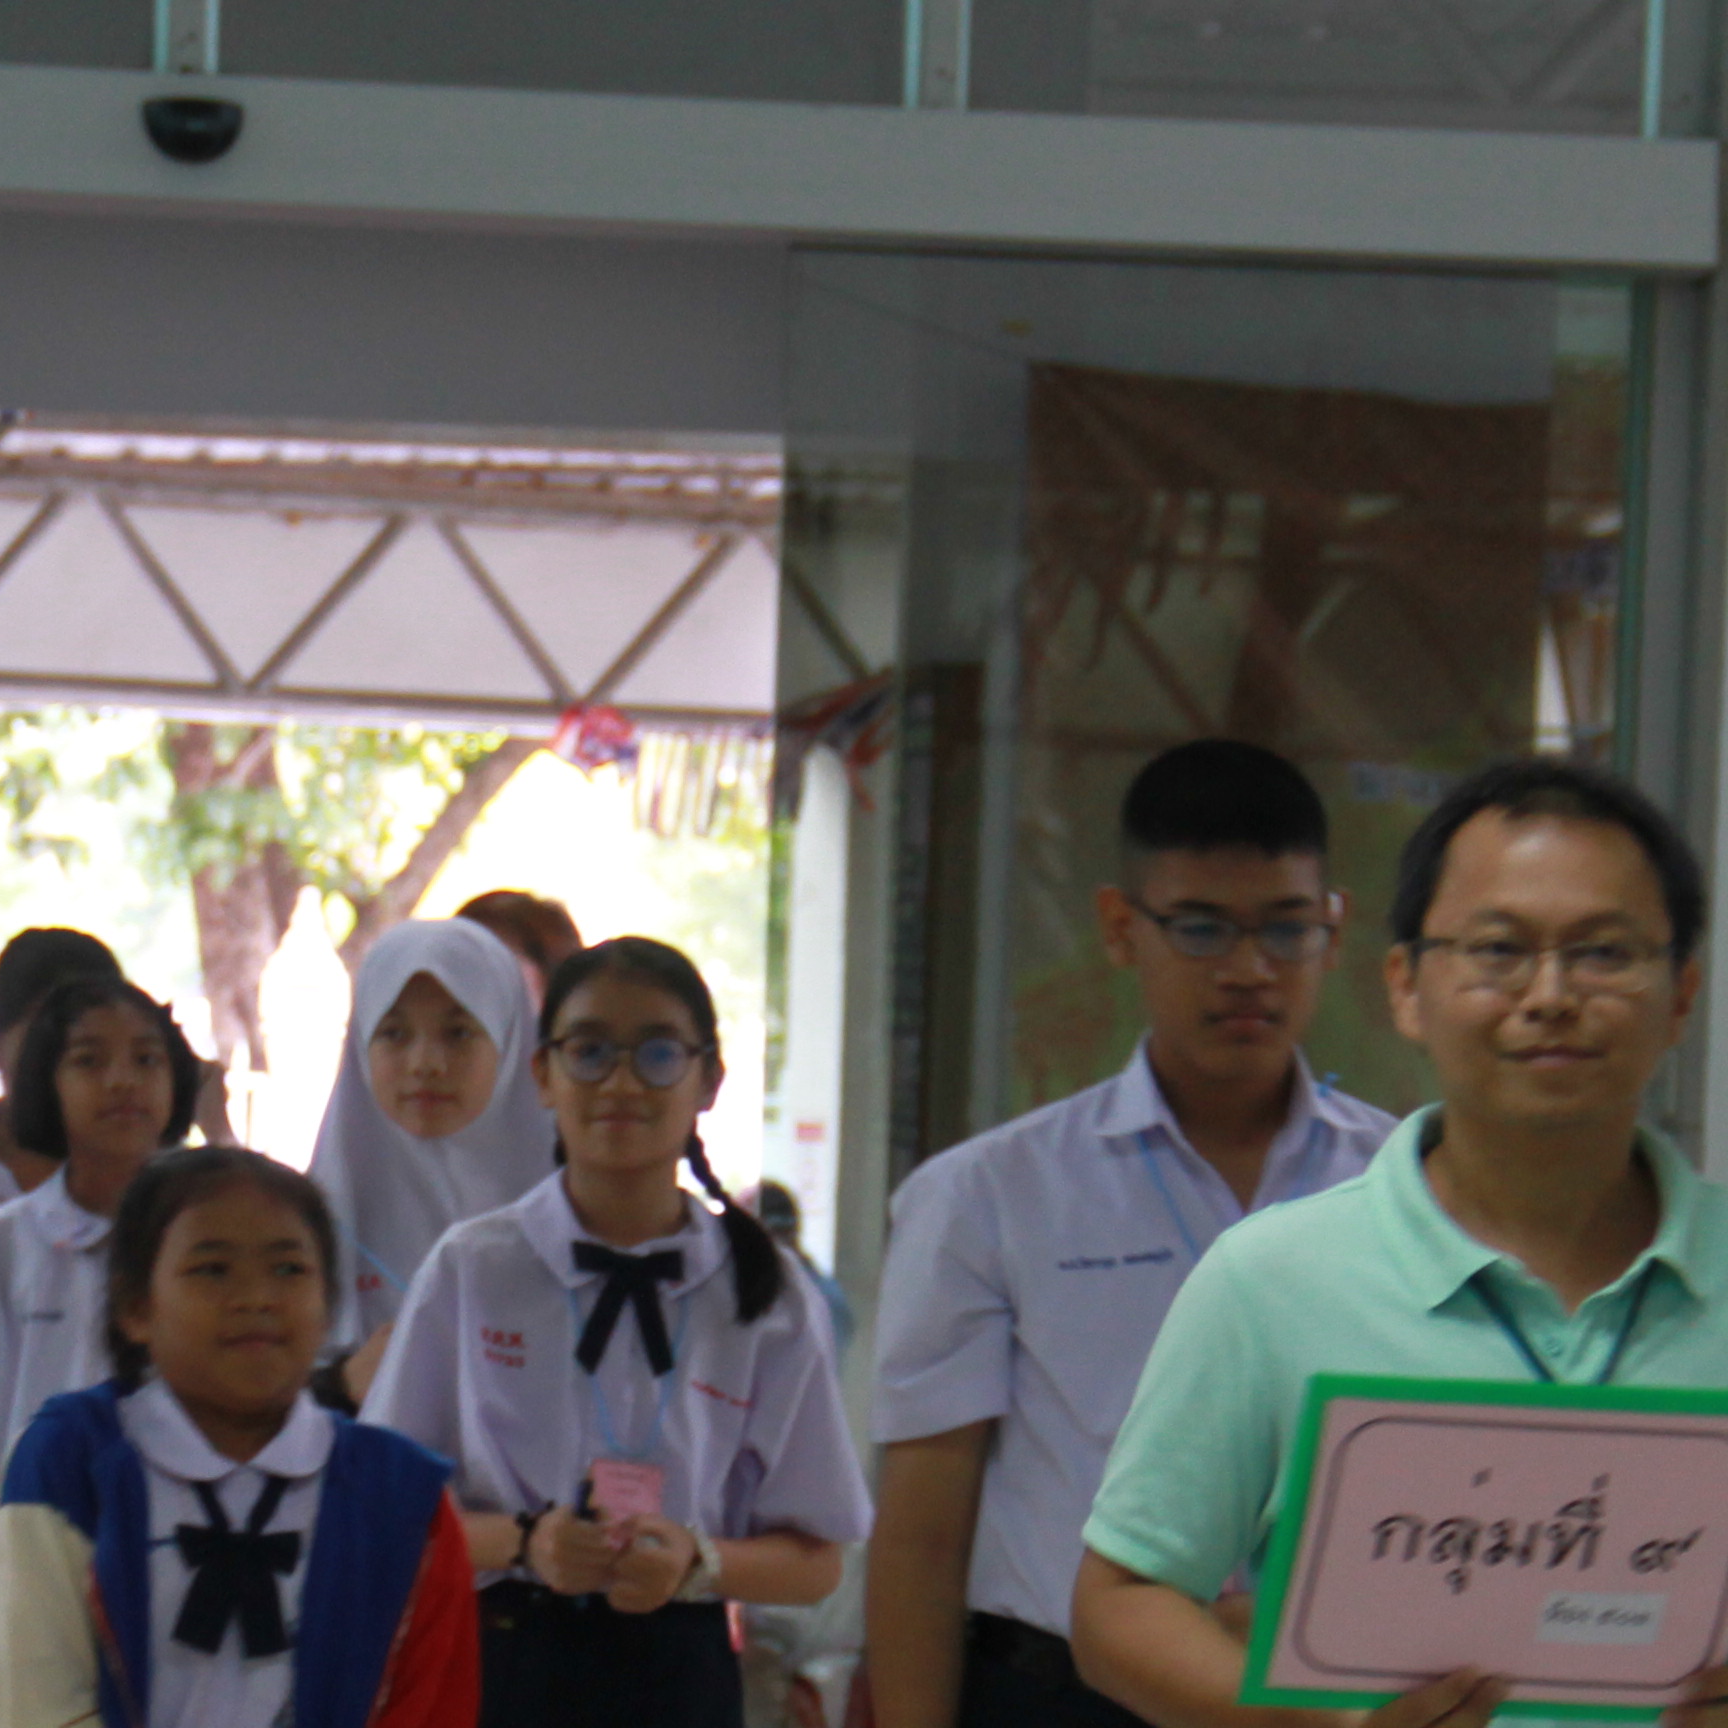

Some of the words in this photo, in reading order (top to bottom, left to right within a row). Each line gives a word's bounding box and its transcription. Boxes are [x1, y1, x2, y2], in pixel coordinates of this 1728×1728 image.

[1371, 1467, 1610, 1595] กลุ่มที่
[1629, 1526, 1705, 1574] ๙
